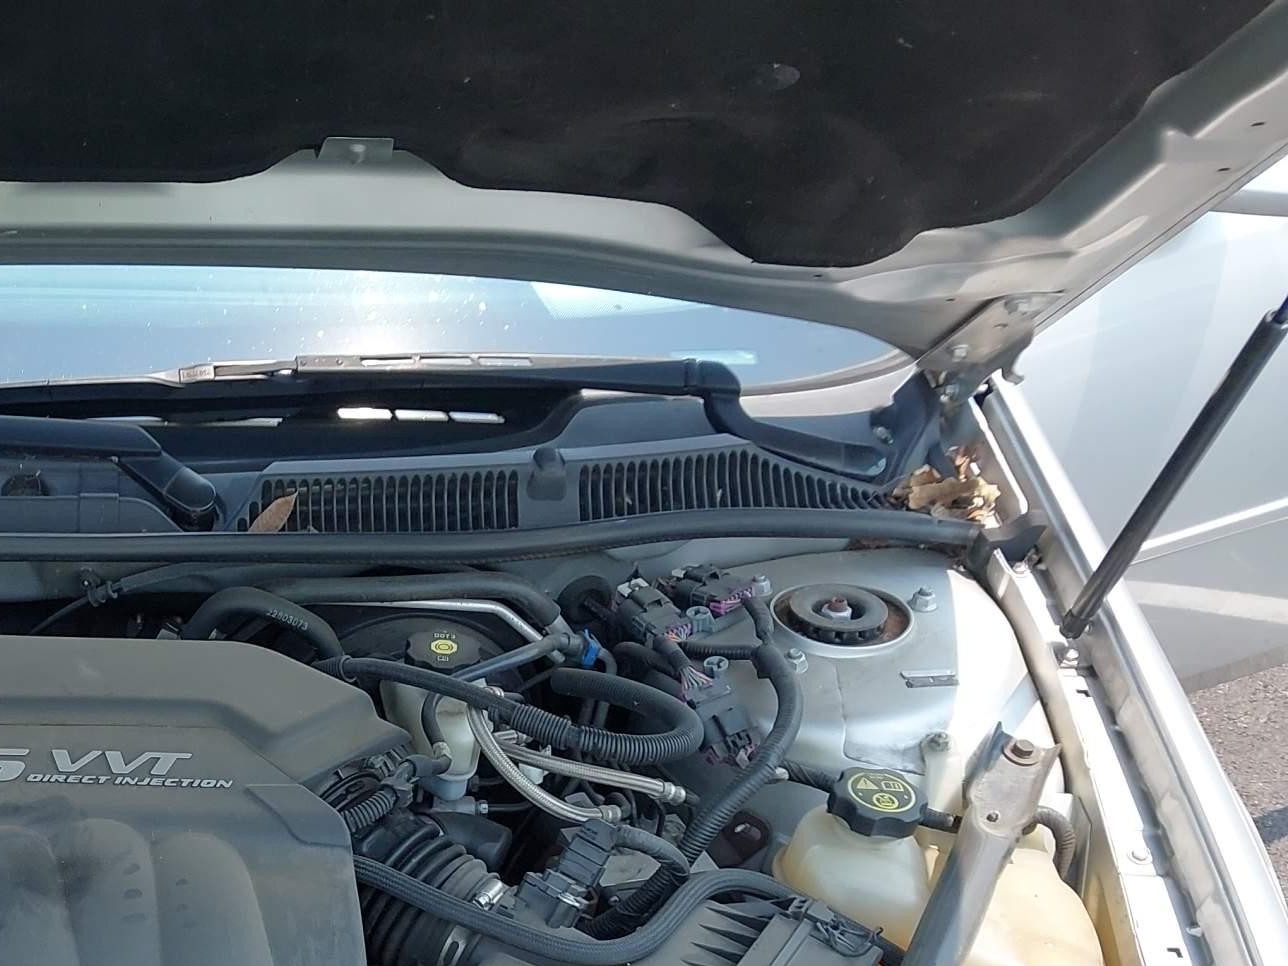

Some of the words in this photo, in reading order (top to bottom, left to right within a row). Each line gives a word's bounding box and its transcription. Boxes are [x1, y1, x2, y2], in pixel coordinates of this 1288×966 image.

[51, 749, 193, 775] VVT
[26, 774, 111, 785] DIRECT
[114, 775, 233, 788] INJECTION
